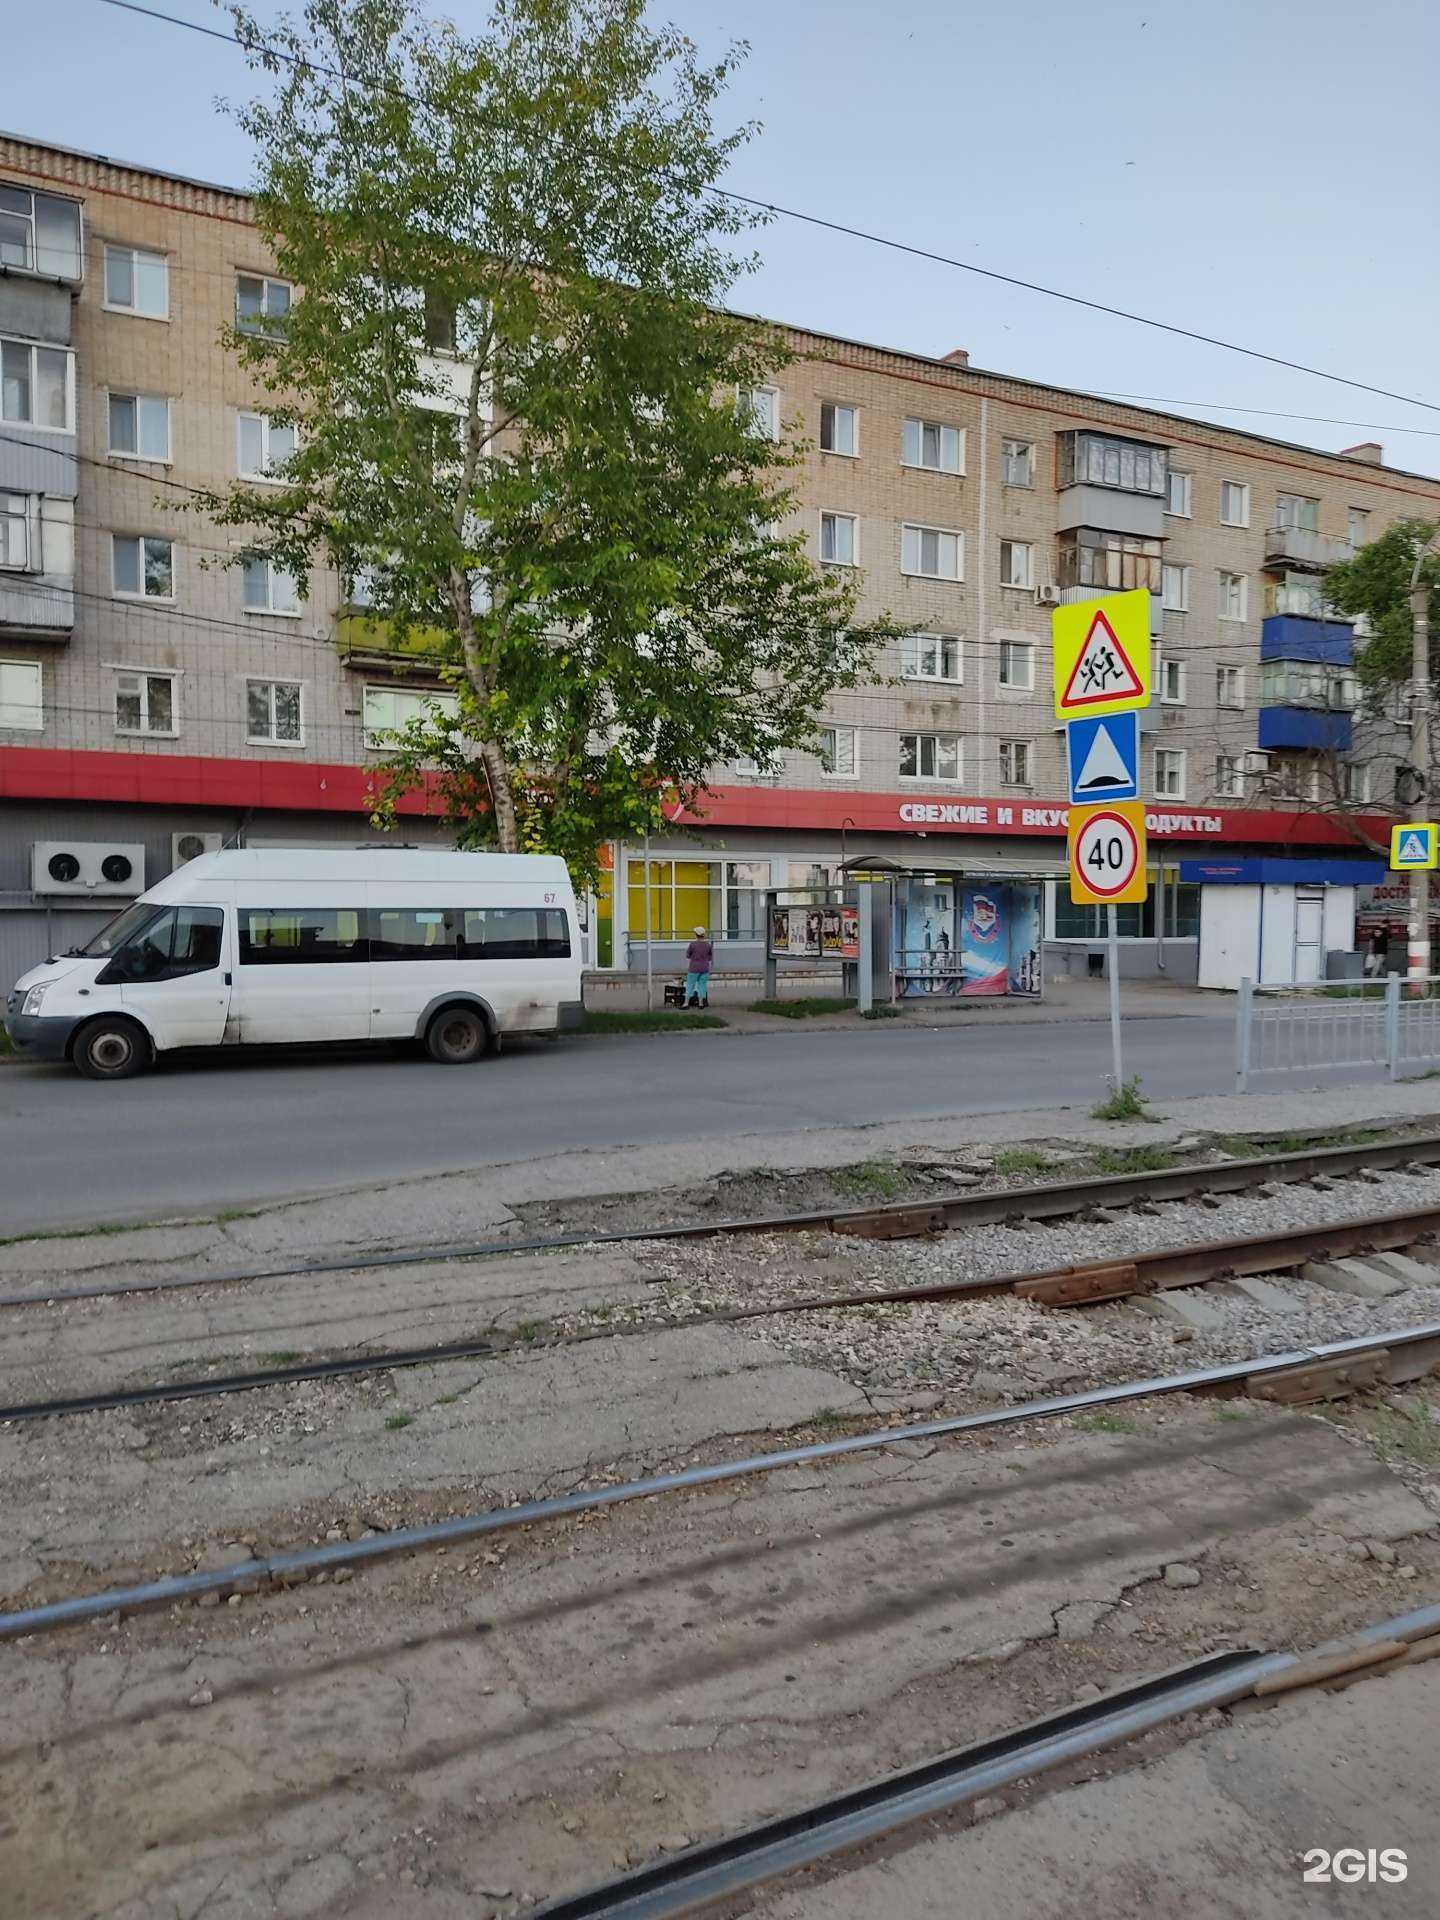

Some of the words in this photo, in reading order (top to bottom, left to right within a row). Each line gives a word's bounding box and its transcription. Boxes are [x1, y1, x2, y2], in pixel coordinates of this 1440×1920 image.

[899, 803, 989, 824] СВЕЖИЕ
[997, 807, 1013, 825] И
[1022, 808, 1069, 827] ВКУС
[1146, 813, 1222, 834] ОДУКТЫ
[1088, 837, 1123, 870] 40
